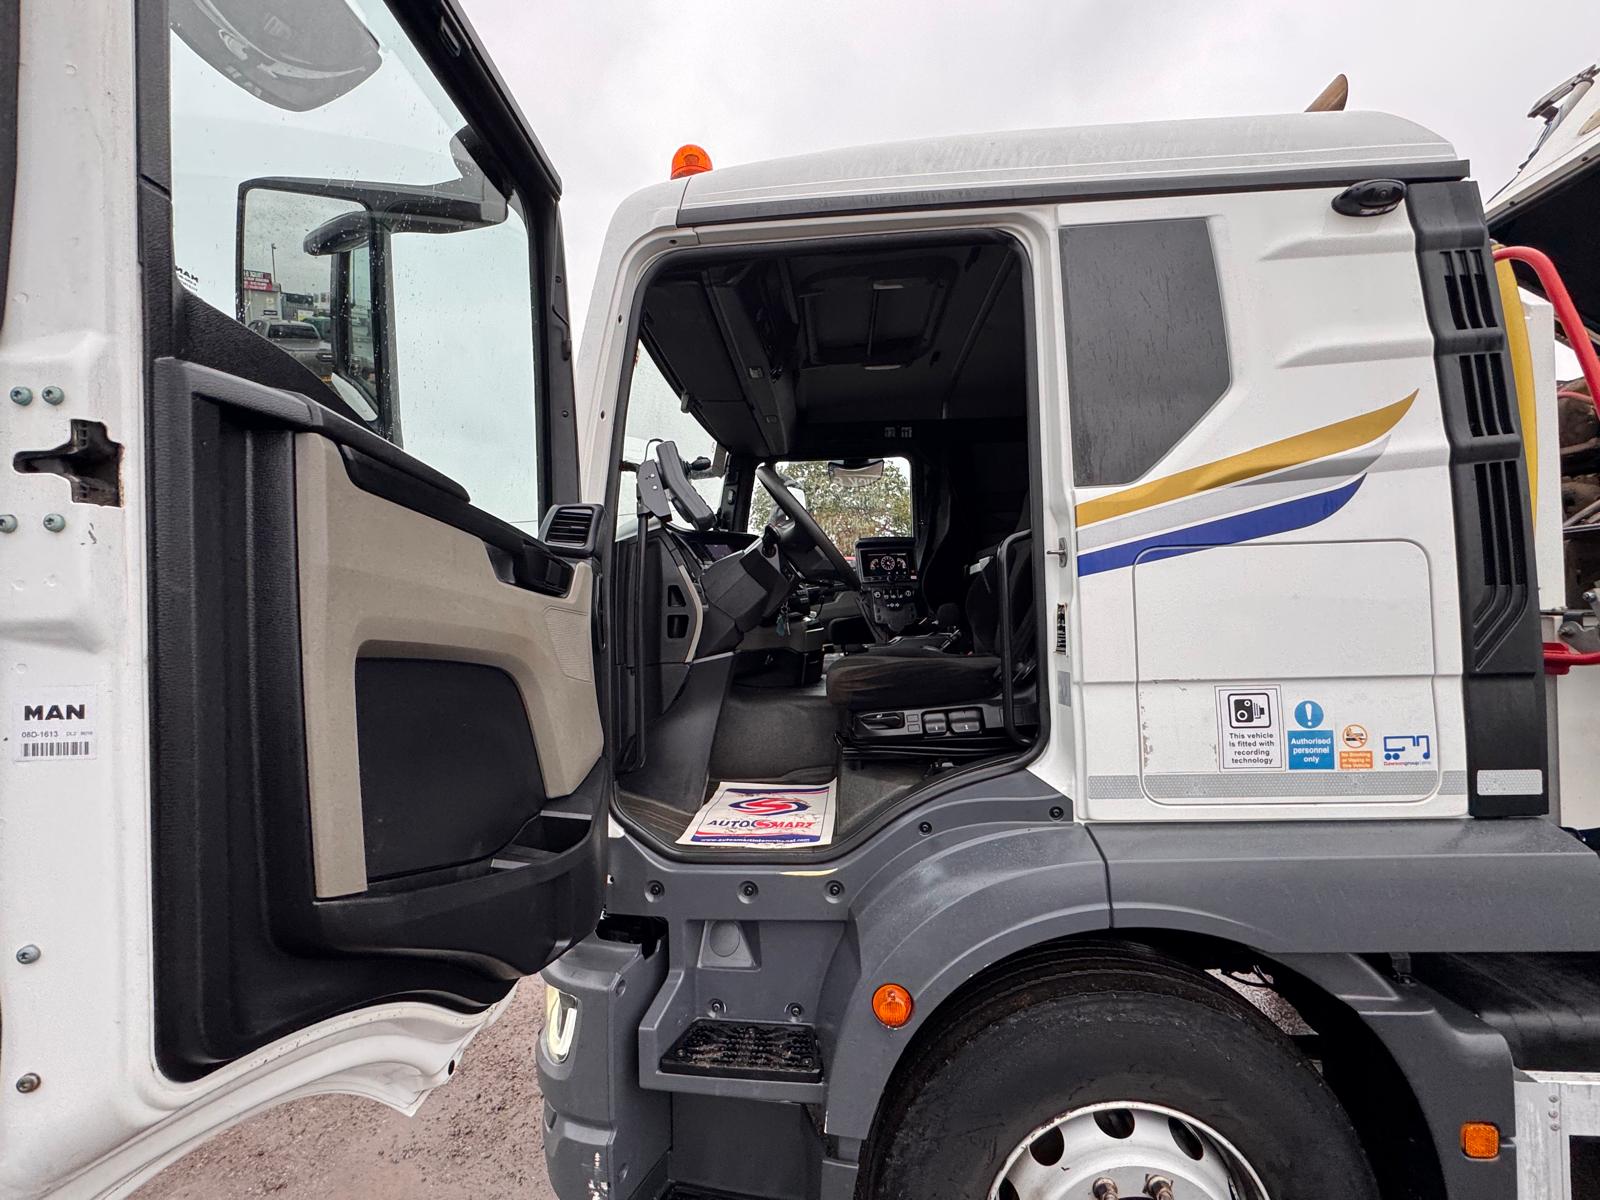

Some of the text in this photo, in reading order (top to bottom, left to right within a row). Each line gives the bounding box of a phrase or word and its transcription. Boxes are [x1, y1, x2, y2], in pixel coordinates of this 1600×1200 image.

[24, 704, 85, 721] MAN
[1238, 740, 1257, 748] fitted
[1258, 740, 1275, 748] with
[1291, 737, 1331, 745] Authorised
[1234, 748, 1270, 757] recording
[1293, 746, 1330, 755] personnel
[1304, 755, 1320, 763] only
